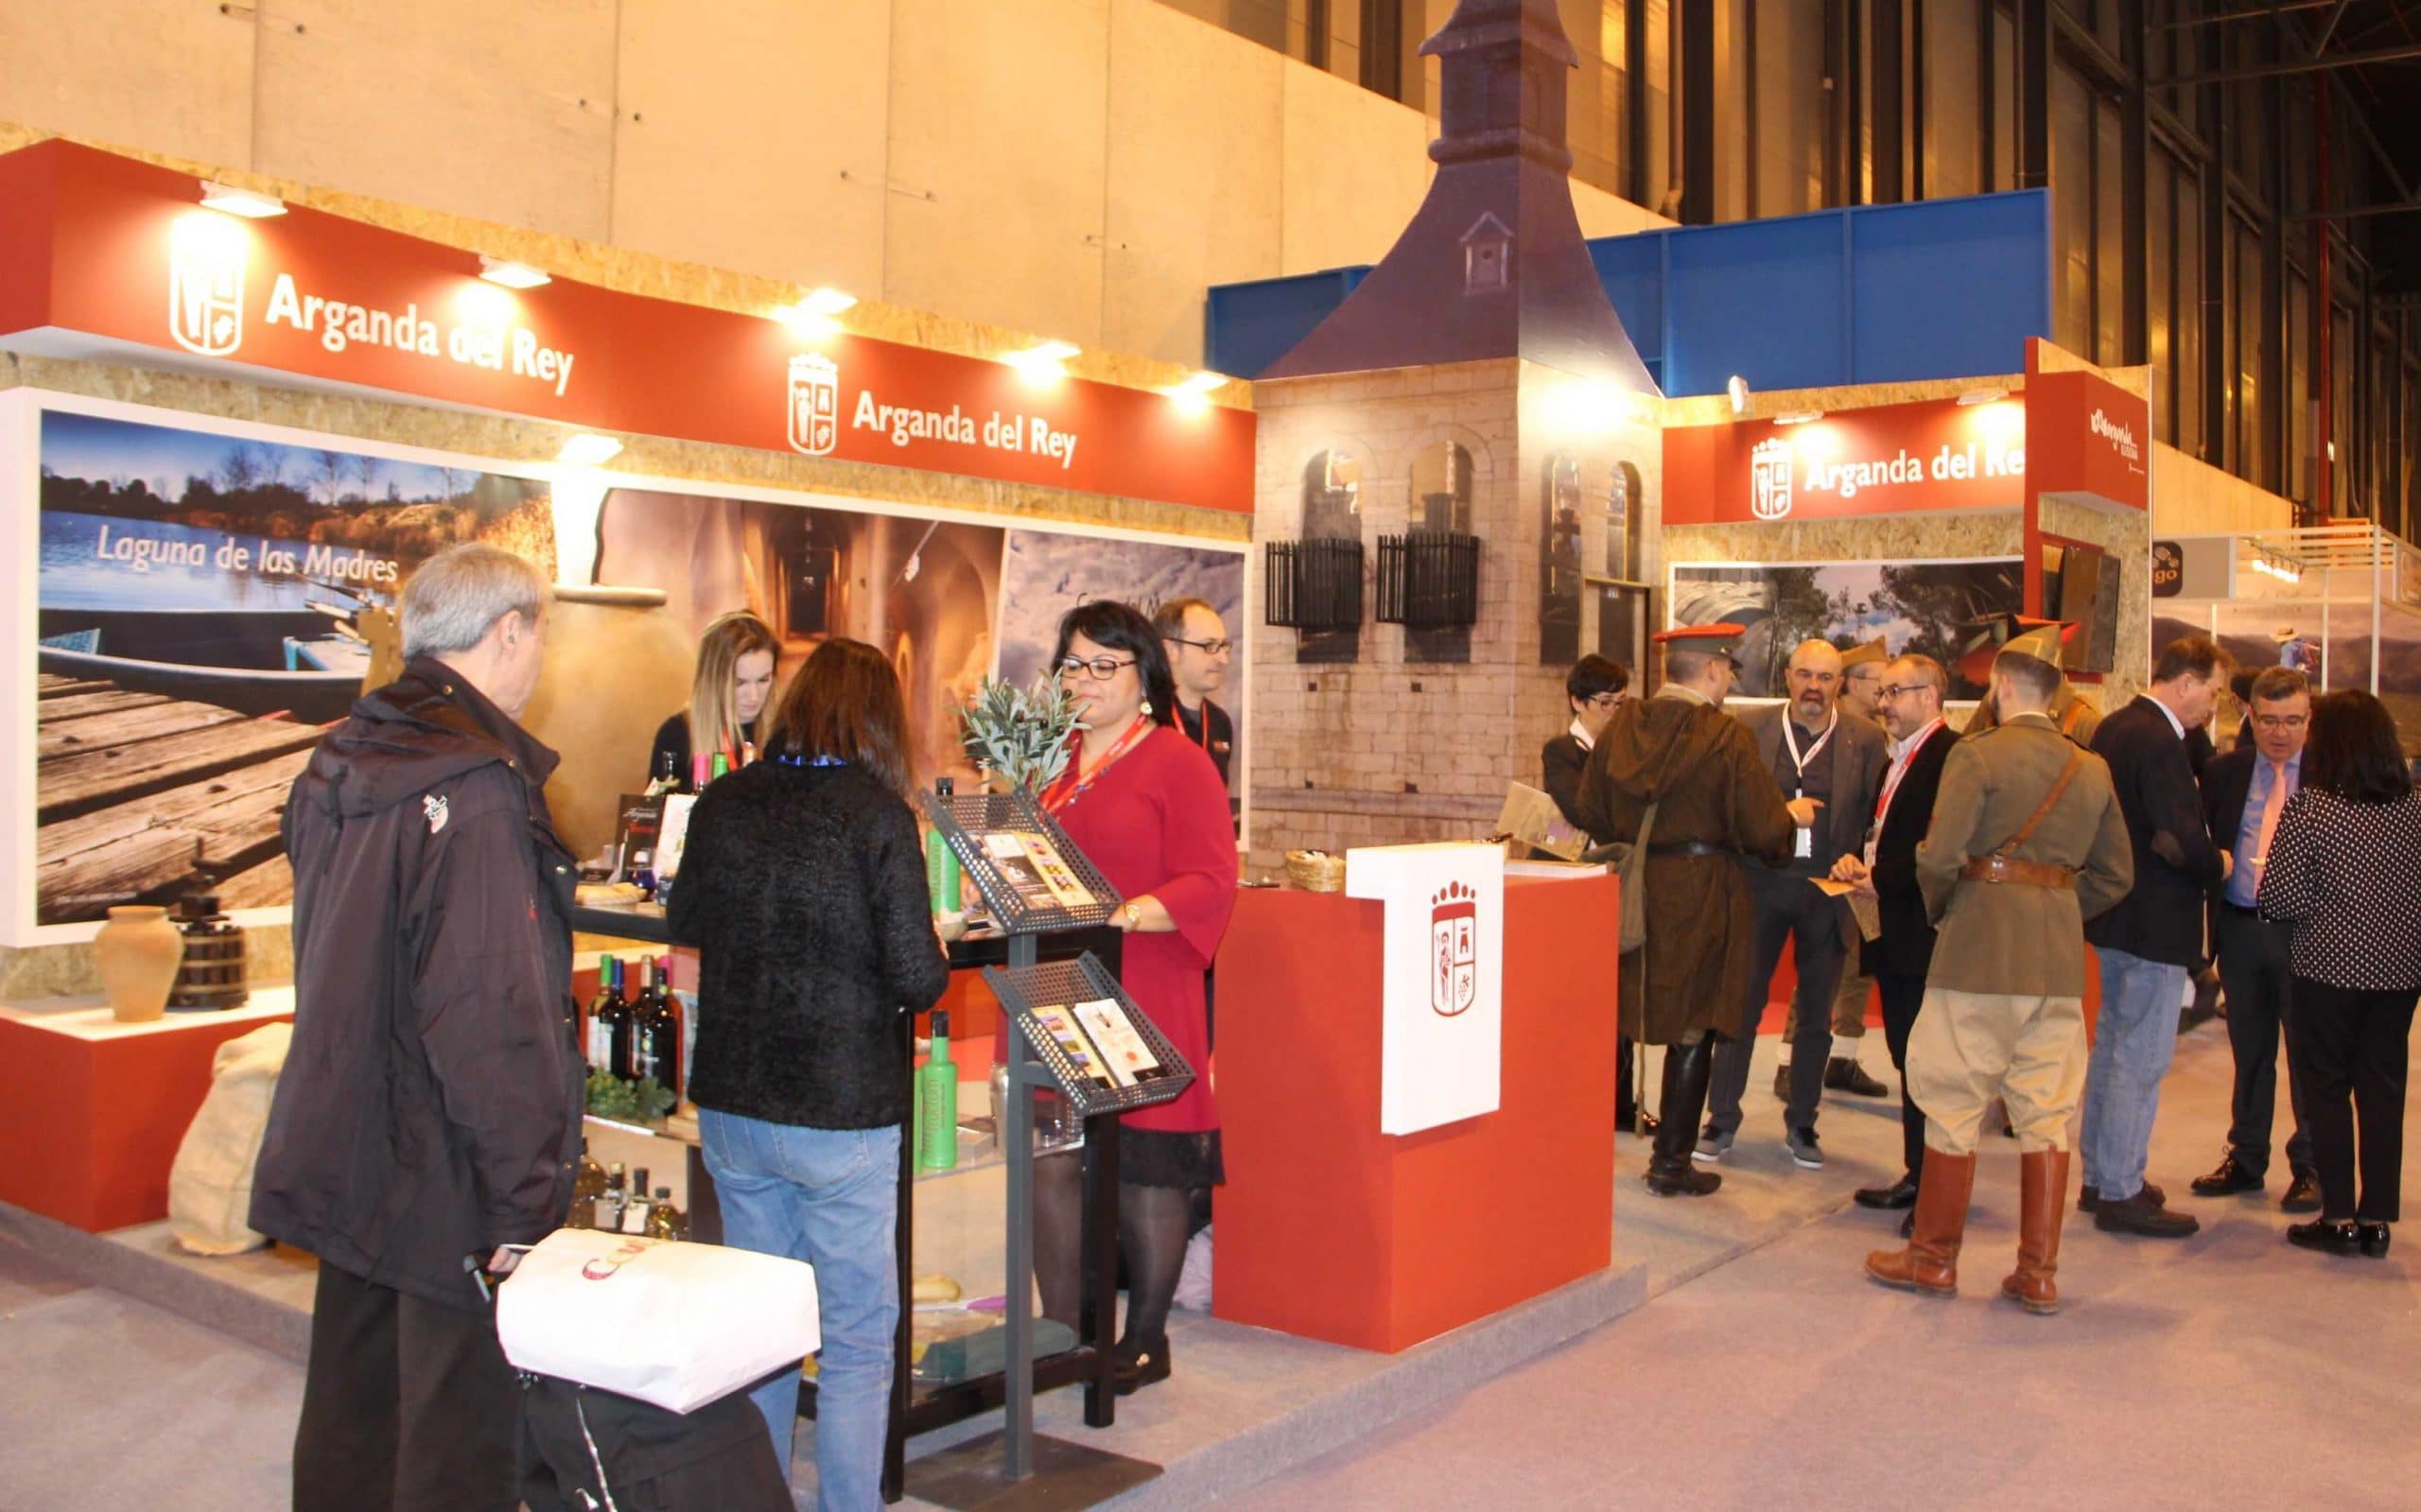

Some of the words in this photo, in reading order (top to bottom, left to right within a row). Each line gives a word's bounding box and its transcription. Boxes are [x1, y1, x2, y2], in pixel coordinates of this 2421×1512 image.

[266, 273, 439, 353] Arganda
[448, 318, 504, 371] del
[512, 326, 574, 397] Rey
[852, 390, 976, 447] Arganda
[984, 410, 1022, 452] del
[1031, 417, 1077, 470] Rey
[1804, 449, 1923, 498] Arganda
[1931, 443, 1976, 480] del
[1986, 443, 2026, 478] Re
[96, 524, 205, 573] Laguna
[216, 536, 250, 571] de
[259, 539, 295, 575] las
[303, 544, 398, 582] Madres
